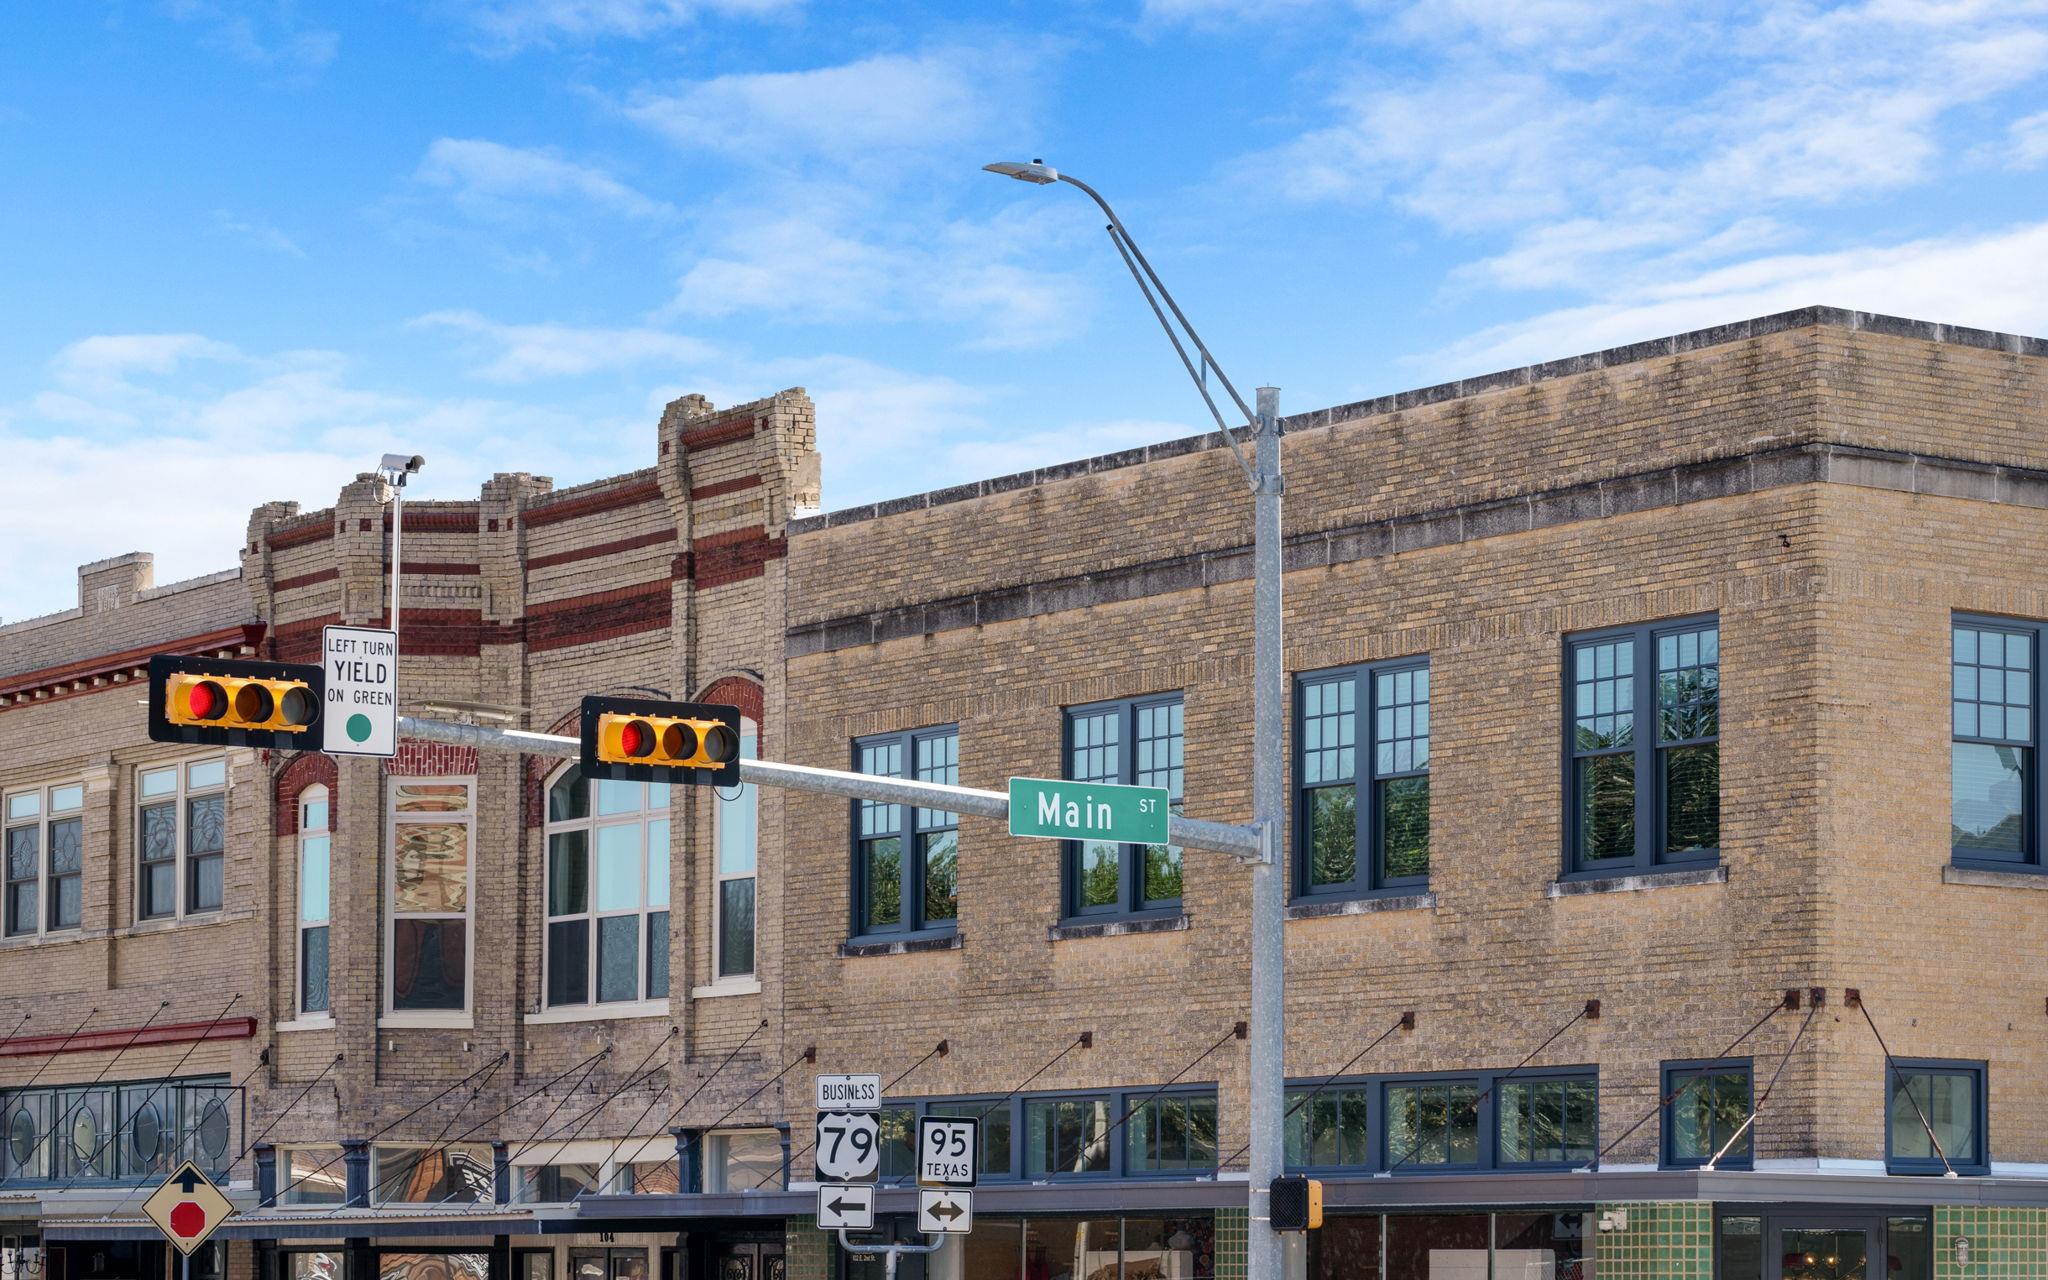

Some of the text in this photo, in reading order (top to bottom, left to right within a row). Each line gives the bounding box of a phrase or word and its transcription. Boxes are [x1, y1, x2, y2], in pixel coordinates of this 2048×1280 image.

[328, 638, 393, 656] LEFT TURN
[334, 660, 387, 684] YIELD
[328, 688, 392, 705] ON GREEN
[1038, 791, 1156, 830] Main ST
[822, 1084, 875, 1100] BUSINESS
[824, 1127, 873, 1164] 79
[930, 1128, 966, 1157] 95
[926, 1163, 968, 1176] TEXAS
